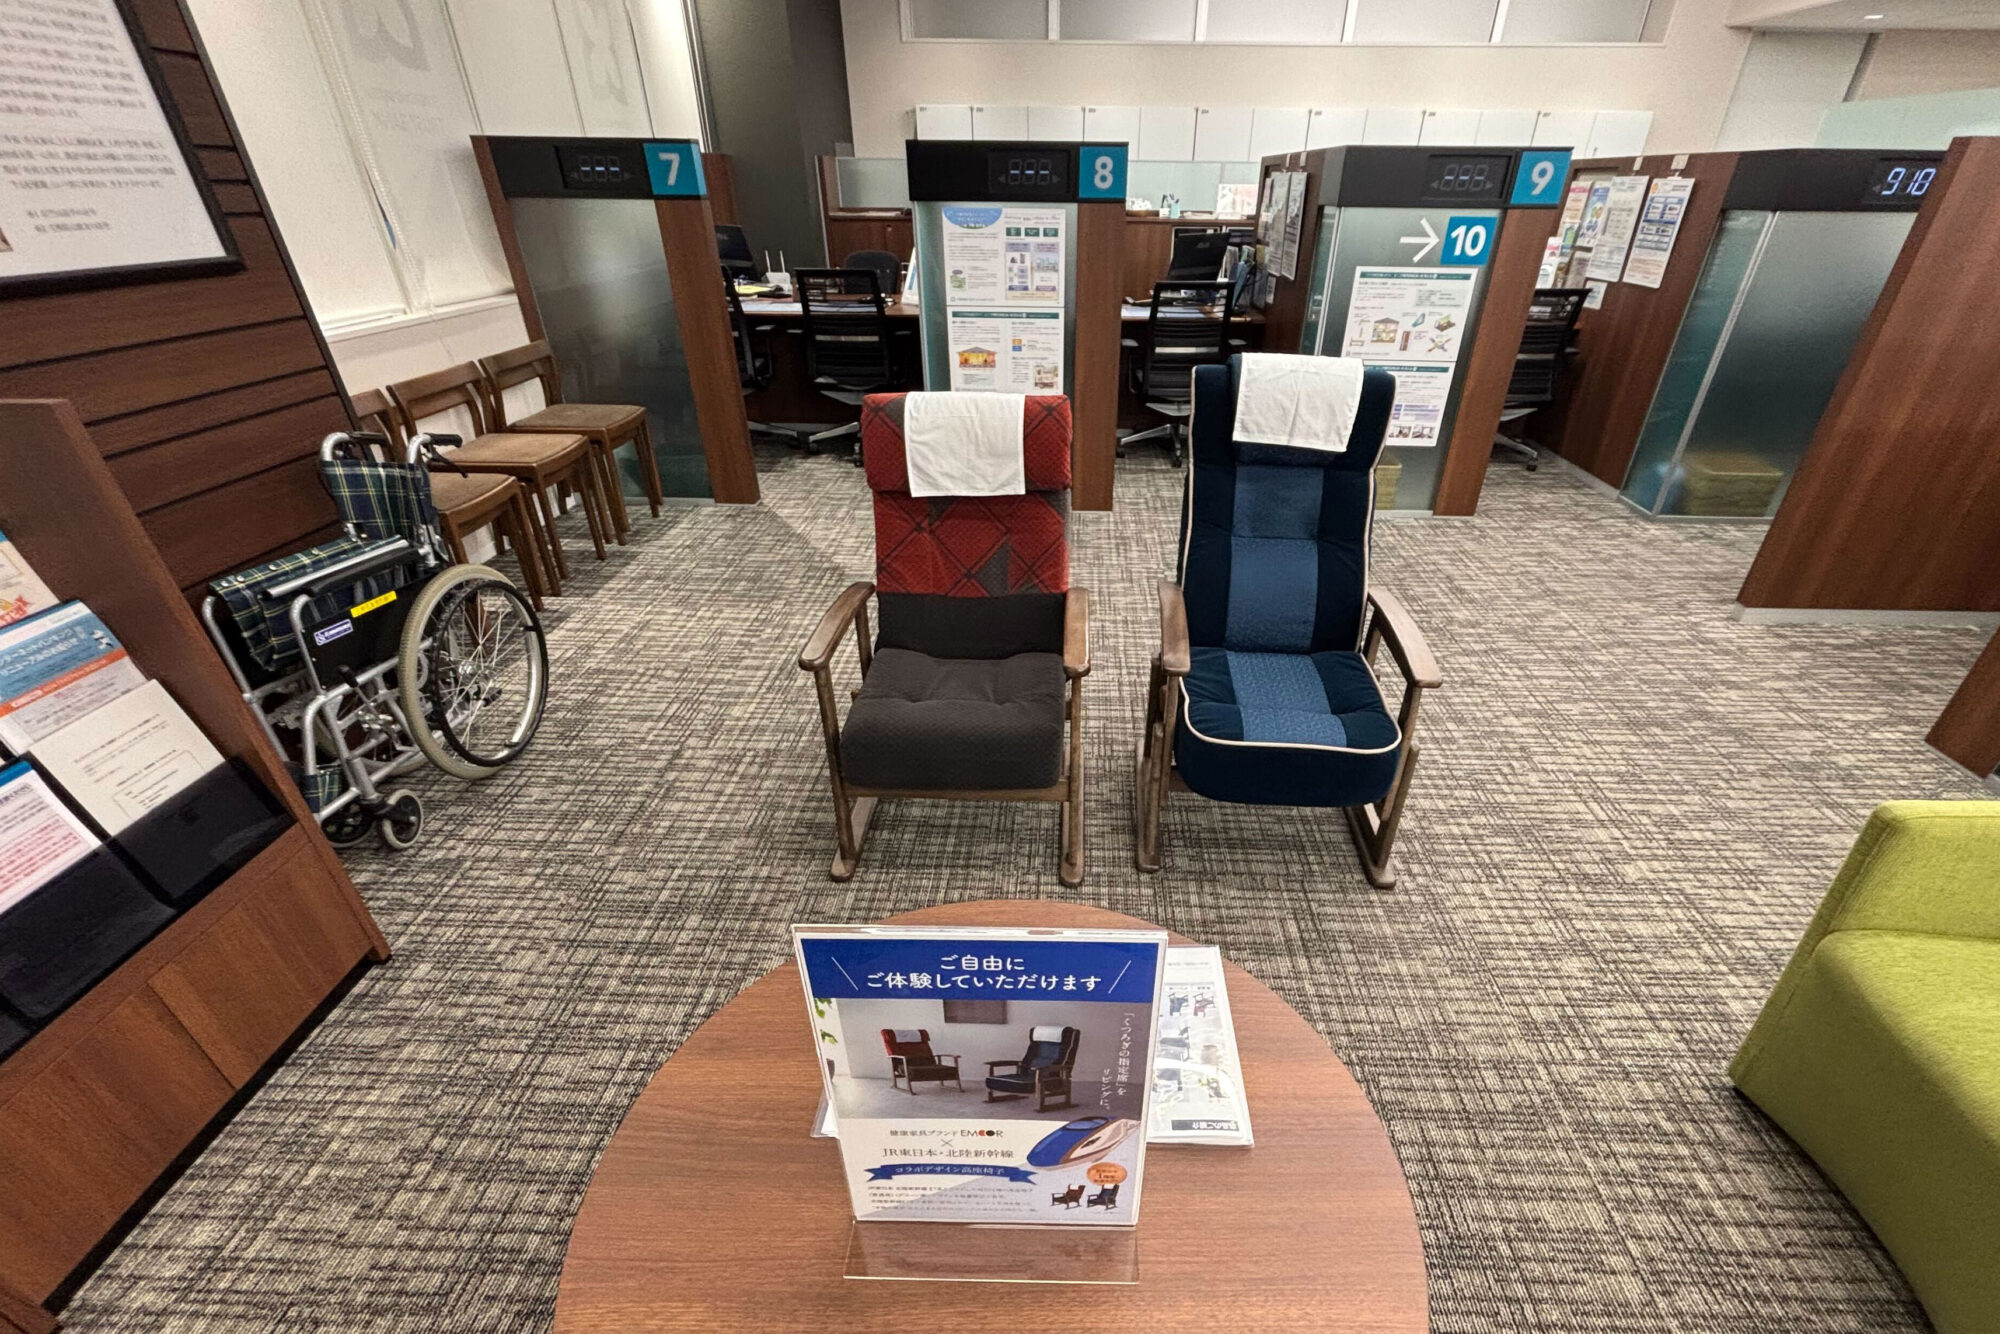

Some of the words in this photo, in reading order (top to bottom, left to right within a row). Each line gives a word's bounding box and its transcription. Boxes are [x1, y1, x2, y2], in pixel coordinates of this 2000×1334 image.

[658, 152, 680, 186] 7
[1093, 155, 1115, 190] 8
[1531, 161, 1555, 195] 9
[1881, 167, 1937, 196] 918
[1450, 224, 1488, 257] 10
[940, 954, 1025, 971] ご自由に
[867, 971, 1102, 991] ご体験していただけます
